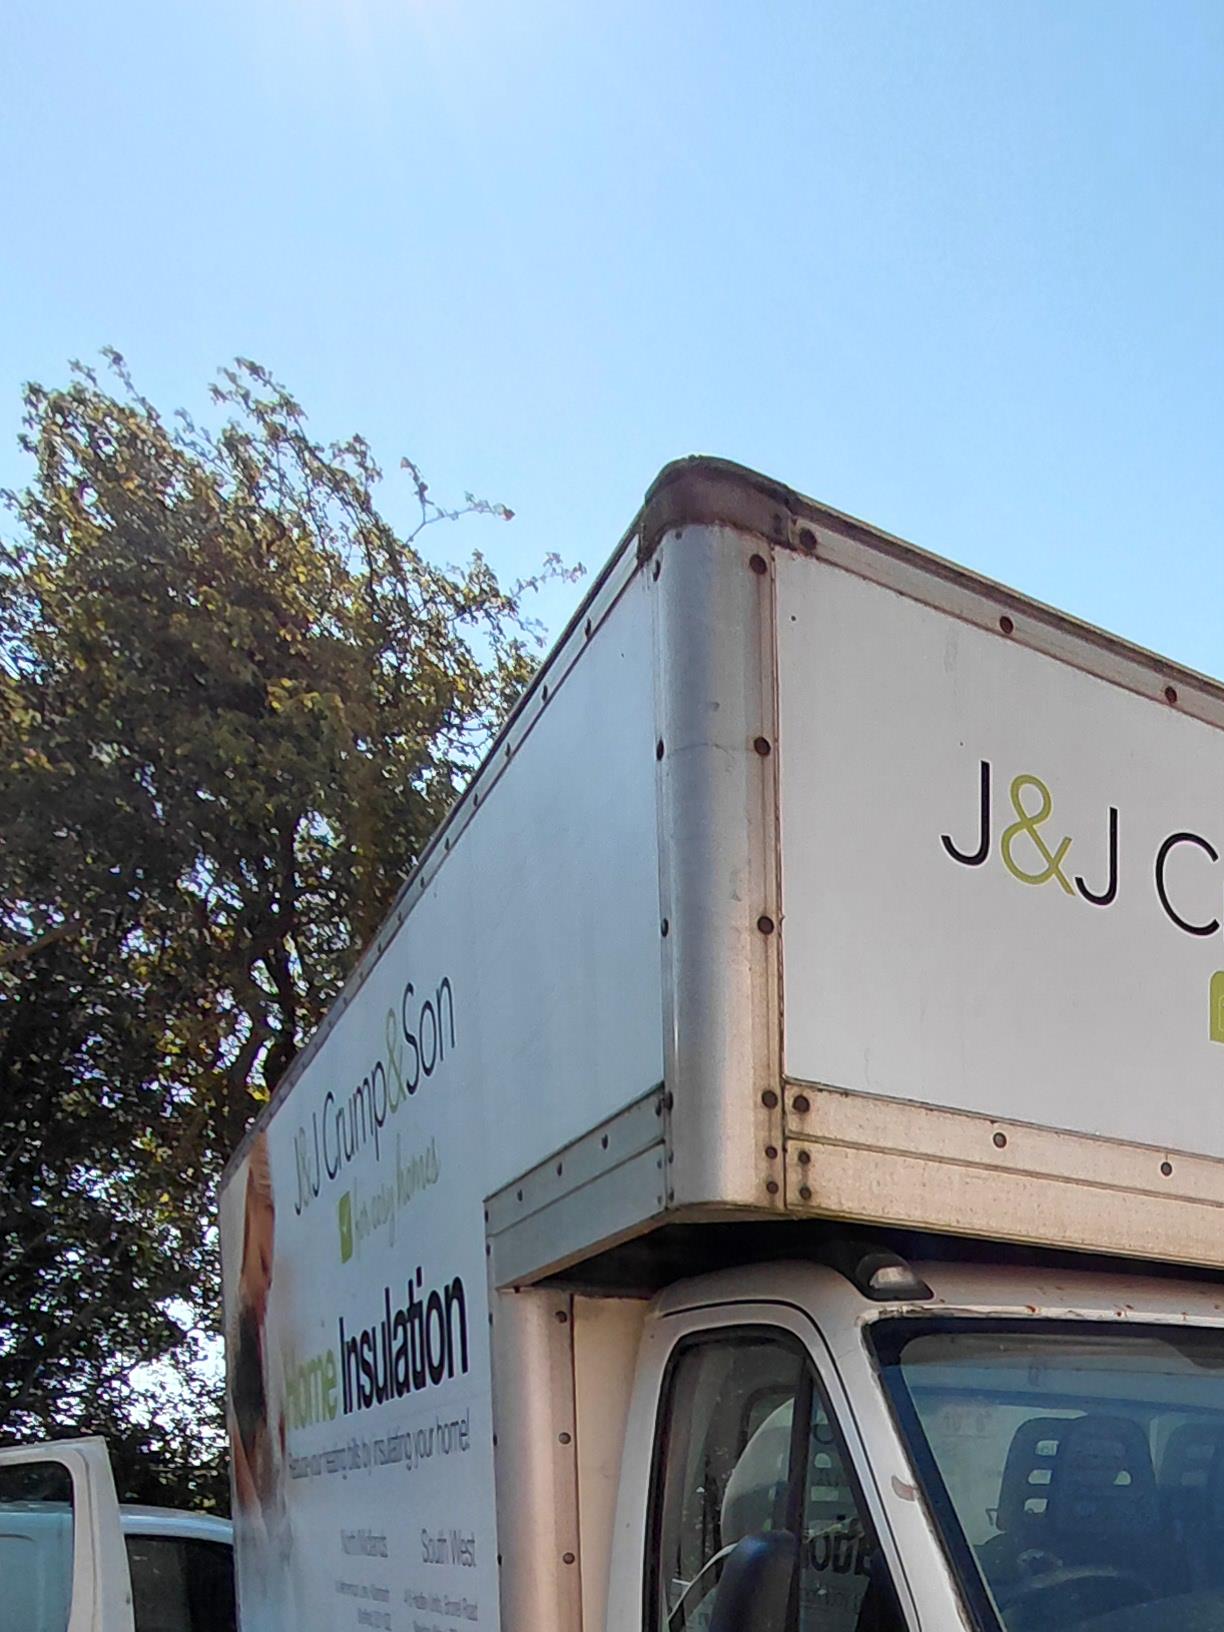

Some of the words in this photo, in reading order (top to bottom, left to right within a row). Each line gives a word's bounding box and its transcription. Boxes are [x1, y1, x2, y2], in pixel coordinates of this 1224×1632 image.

[941, 760, 1118, 906] J&J
[294, 1112, 321, 1216] J&J
[322, 976, 456, 1181] Crump&Son
[339, 1266, 469, 1415] Insulation
[421, 1527, 447, 1564] South
[450, 1528, 476, 1567] West
